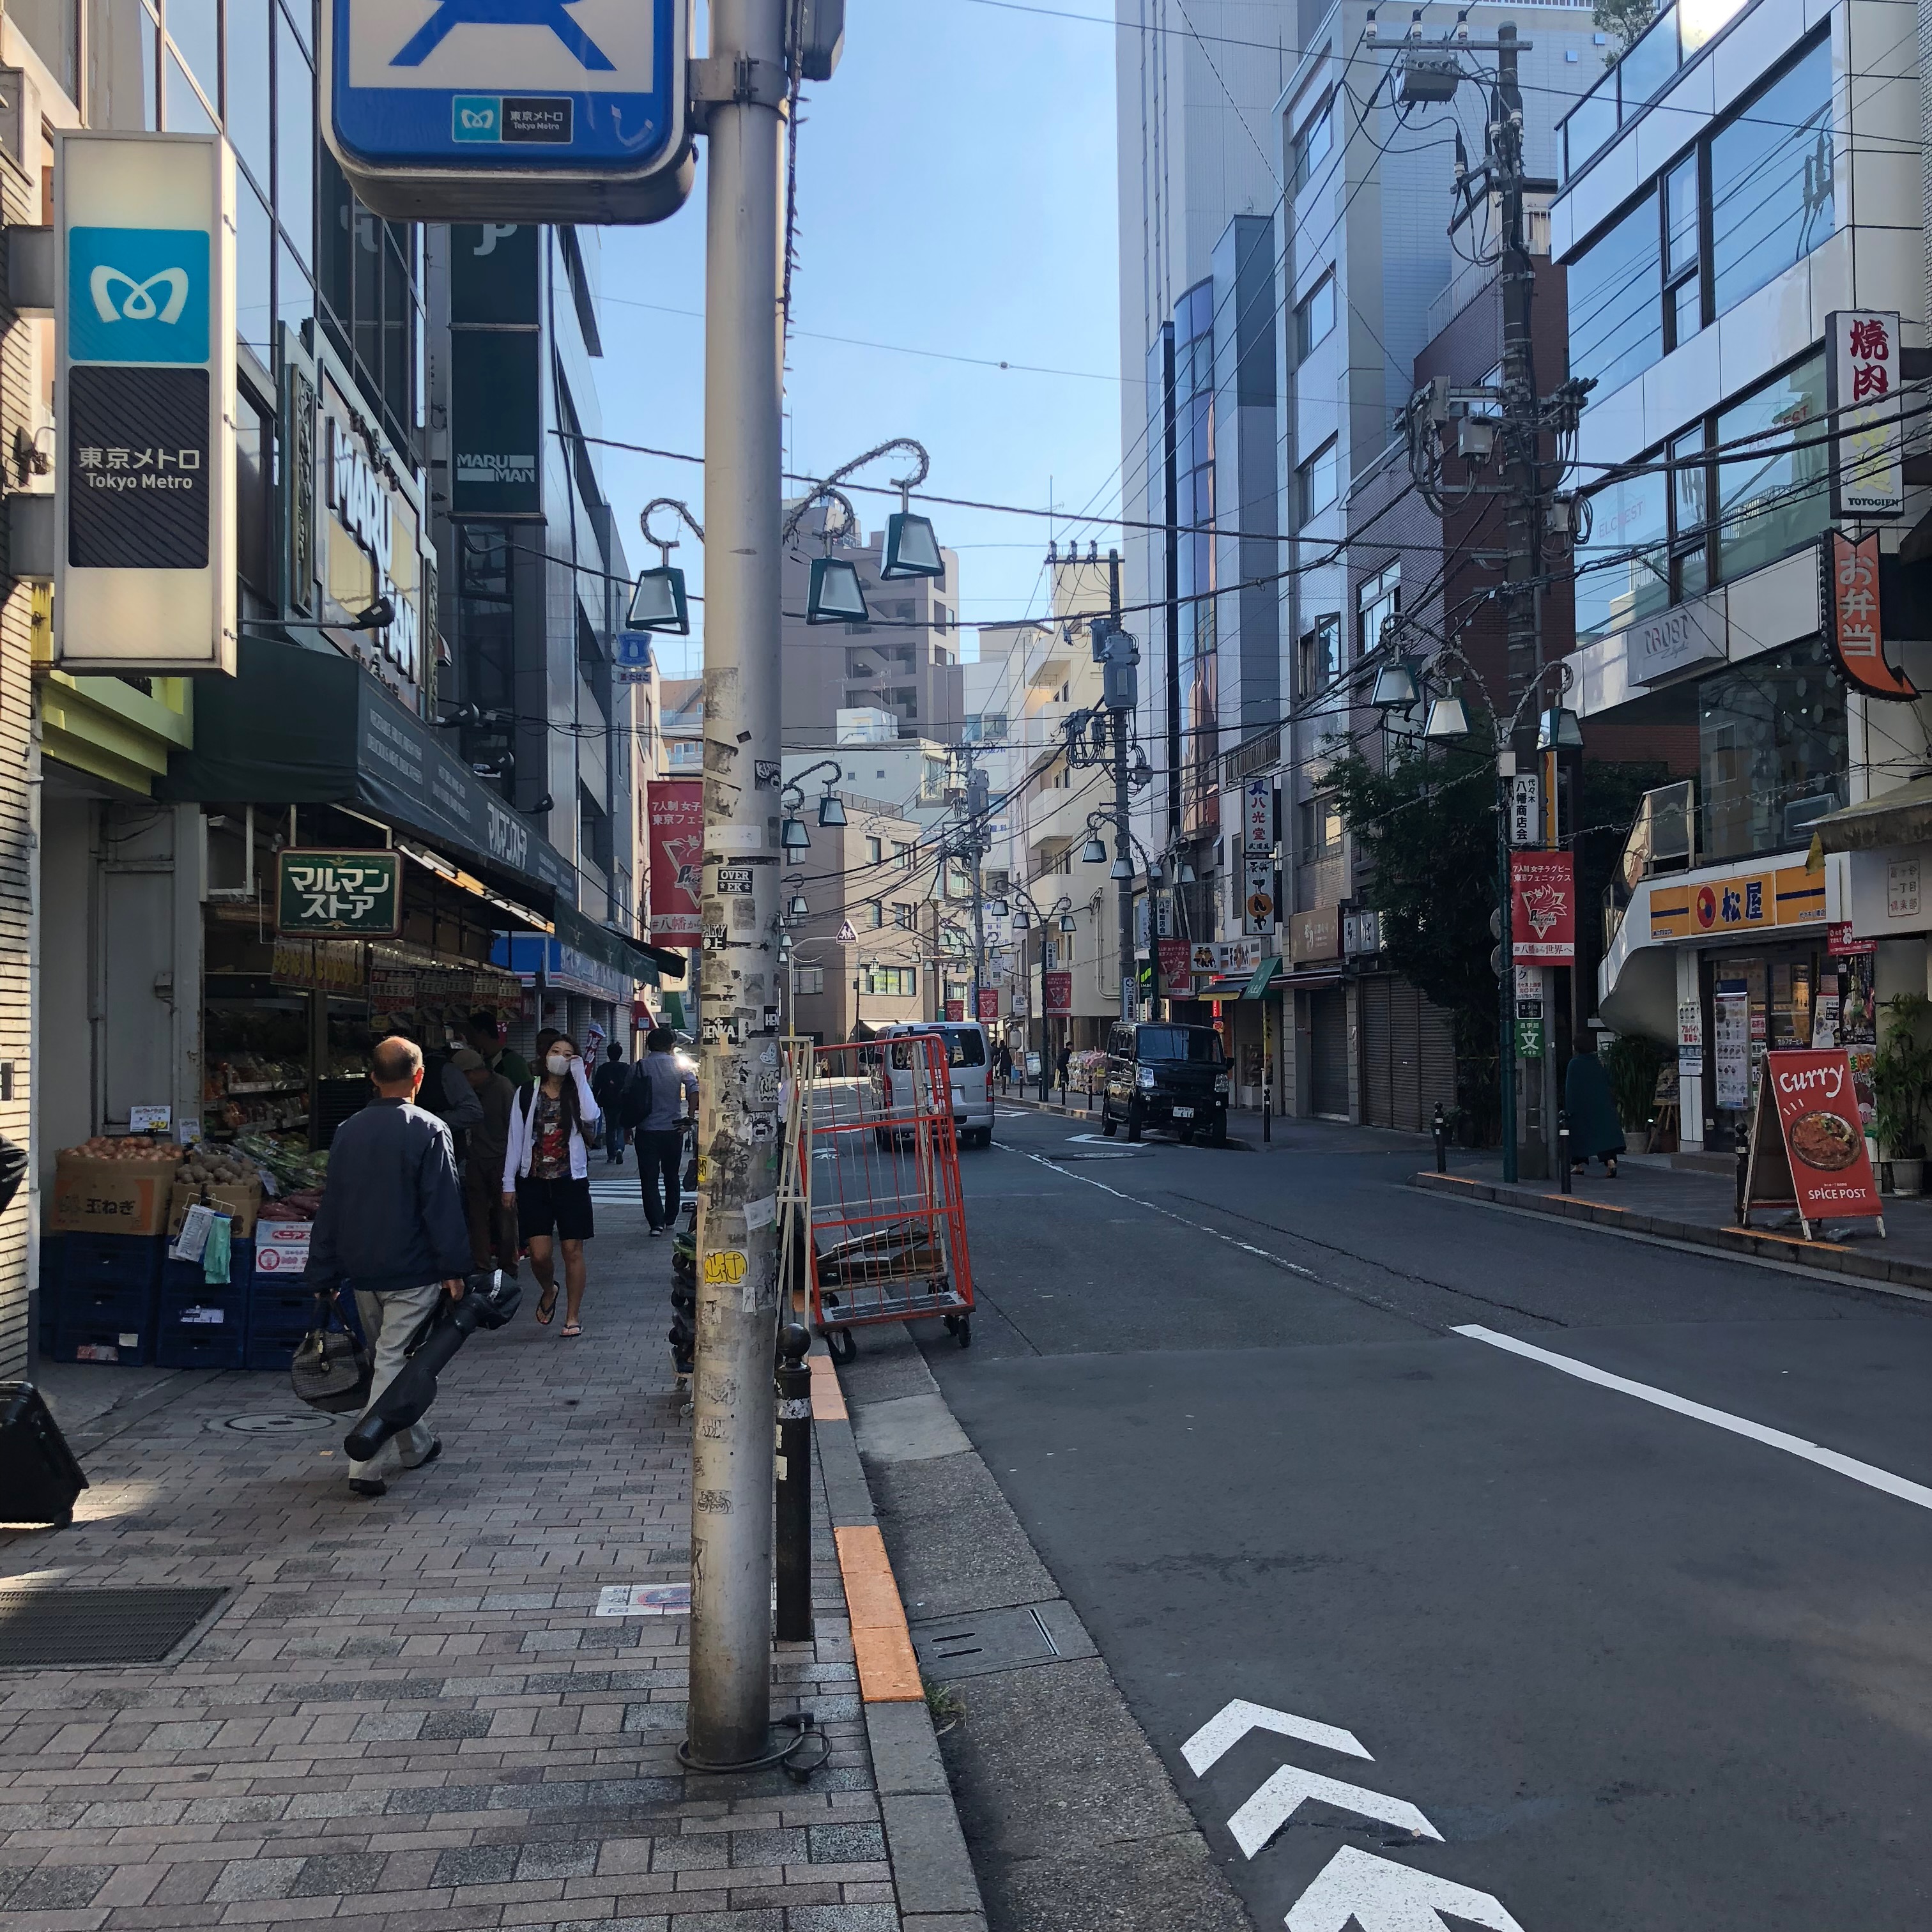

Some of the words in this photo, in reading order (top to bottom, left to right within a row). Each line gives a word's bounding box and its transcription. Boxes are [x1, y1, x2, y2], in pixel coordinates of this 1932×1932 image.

[510, 111, 563, 121] 東京メトロ
[514, 122, 535, 131] Tokyo
[79, 446, 200, 470] 東京メトロ
[456, 453, 511, 473] MARU
[86, 472, 137, 491] Tokyo
[142, 473, 193, 489] Metro
[495, 470, 535, 483] MAN
[327, 417, 393, 575] MARU
[1847, 497, 1899, 507] YOYOGIEN
[1839, 558, 1876, 657] お弁当
[1644, 615, 1688, 654] TRUST
[652, 801, 678, 811] 7人制
[1516, 781, 1528, 840] 八幡商店会
[1251, 796, 1266, 841] 八光堂
[720, 870, 749, 880] OVER
[1514, 874, 1572, 882] 東京フェニックス
[1530, 865, 1571, 873] 女子ラグビー
[288, 866, 390, 894] マルマン
[1890, 881, 1917, 894] 一丁目
[300, 894, 376, 920] ストア
[1721, 880, 1764, 923] 松屋
[1521, 1030, 1539, 1050] 文
[1808, 1187, 1837, 1200] SPICE
[1839, 1188, 1866, 1199] POST
[85, 1198, 136, 1215] 玉ねぎ
